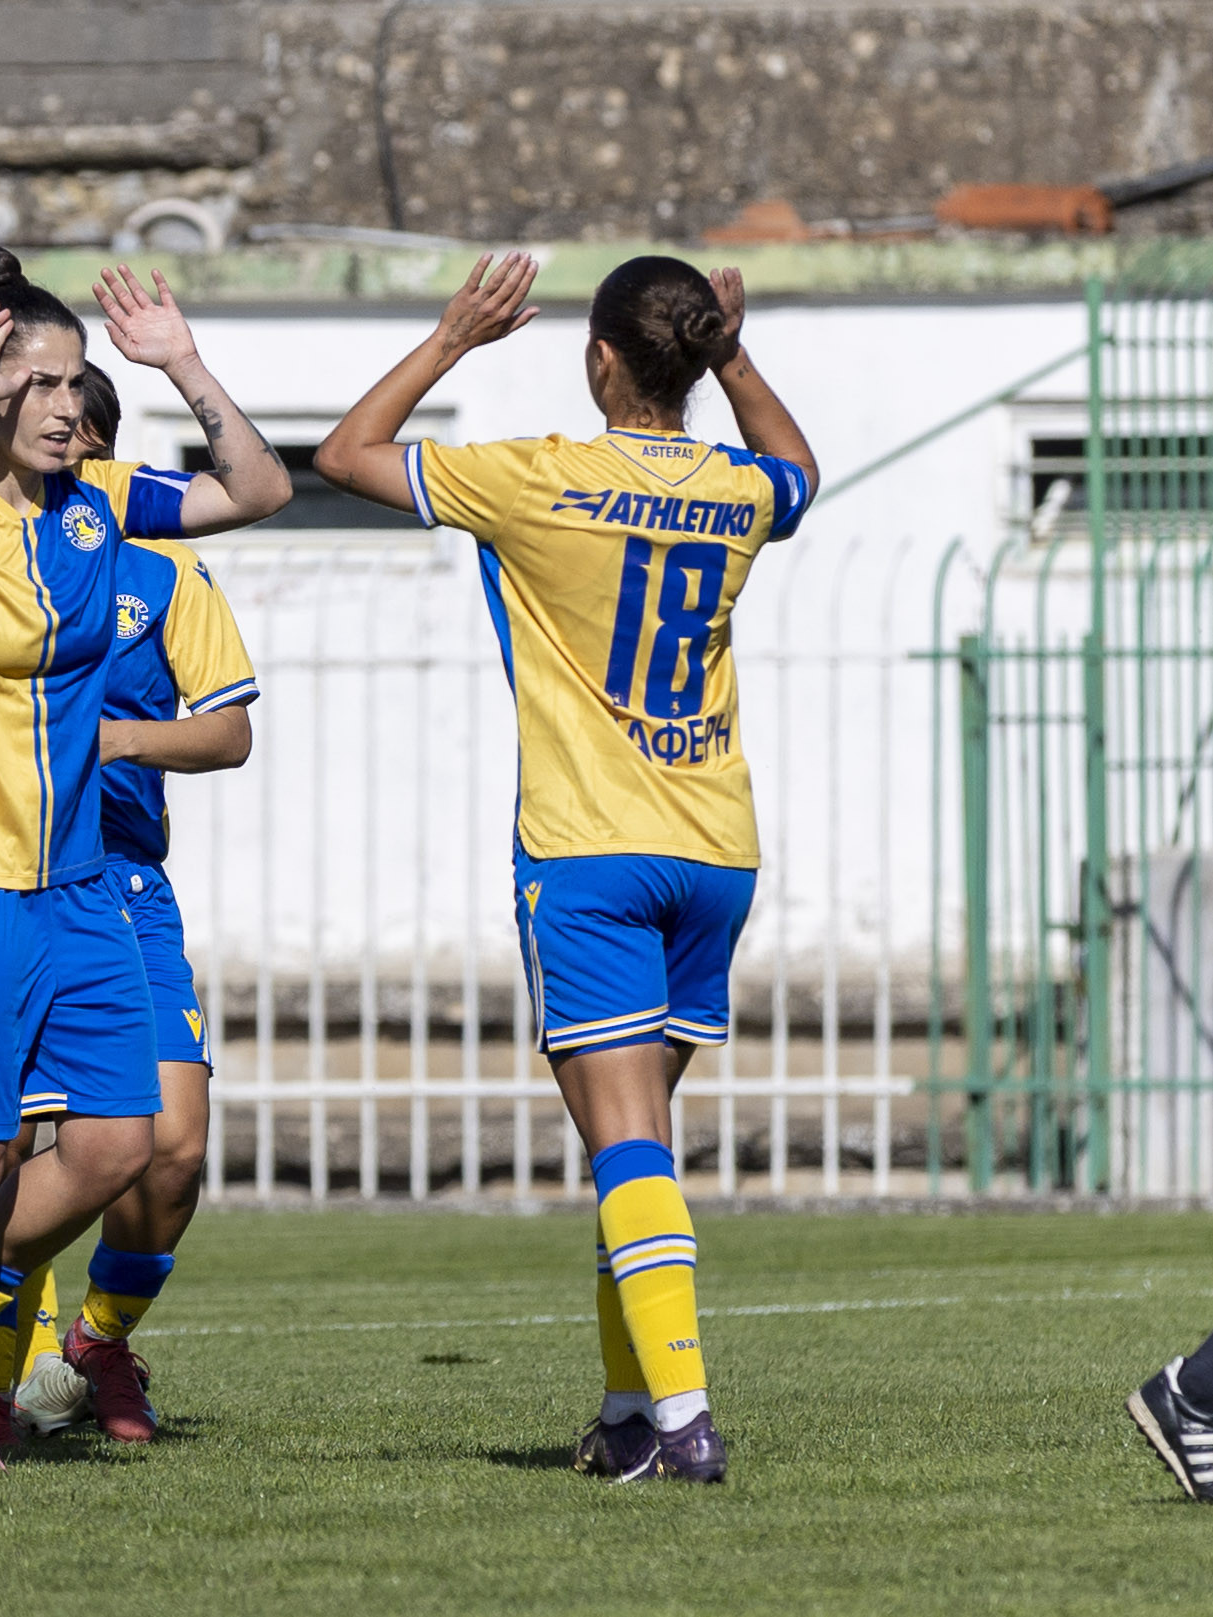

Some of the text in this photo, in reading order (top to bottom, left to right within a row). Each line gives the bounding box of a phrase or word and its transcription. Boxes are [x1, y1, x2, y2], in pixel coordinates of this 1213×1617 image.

[642, 446, 693, 460] ASTERAS
[604, 491, 756, 538] ATHLETIKO
[604, 536, 728, 720] 18
[613, 713, 731, 766] ΑΦΕΡΗ
